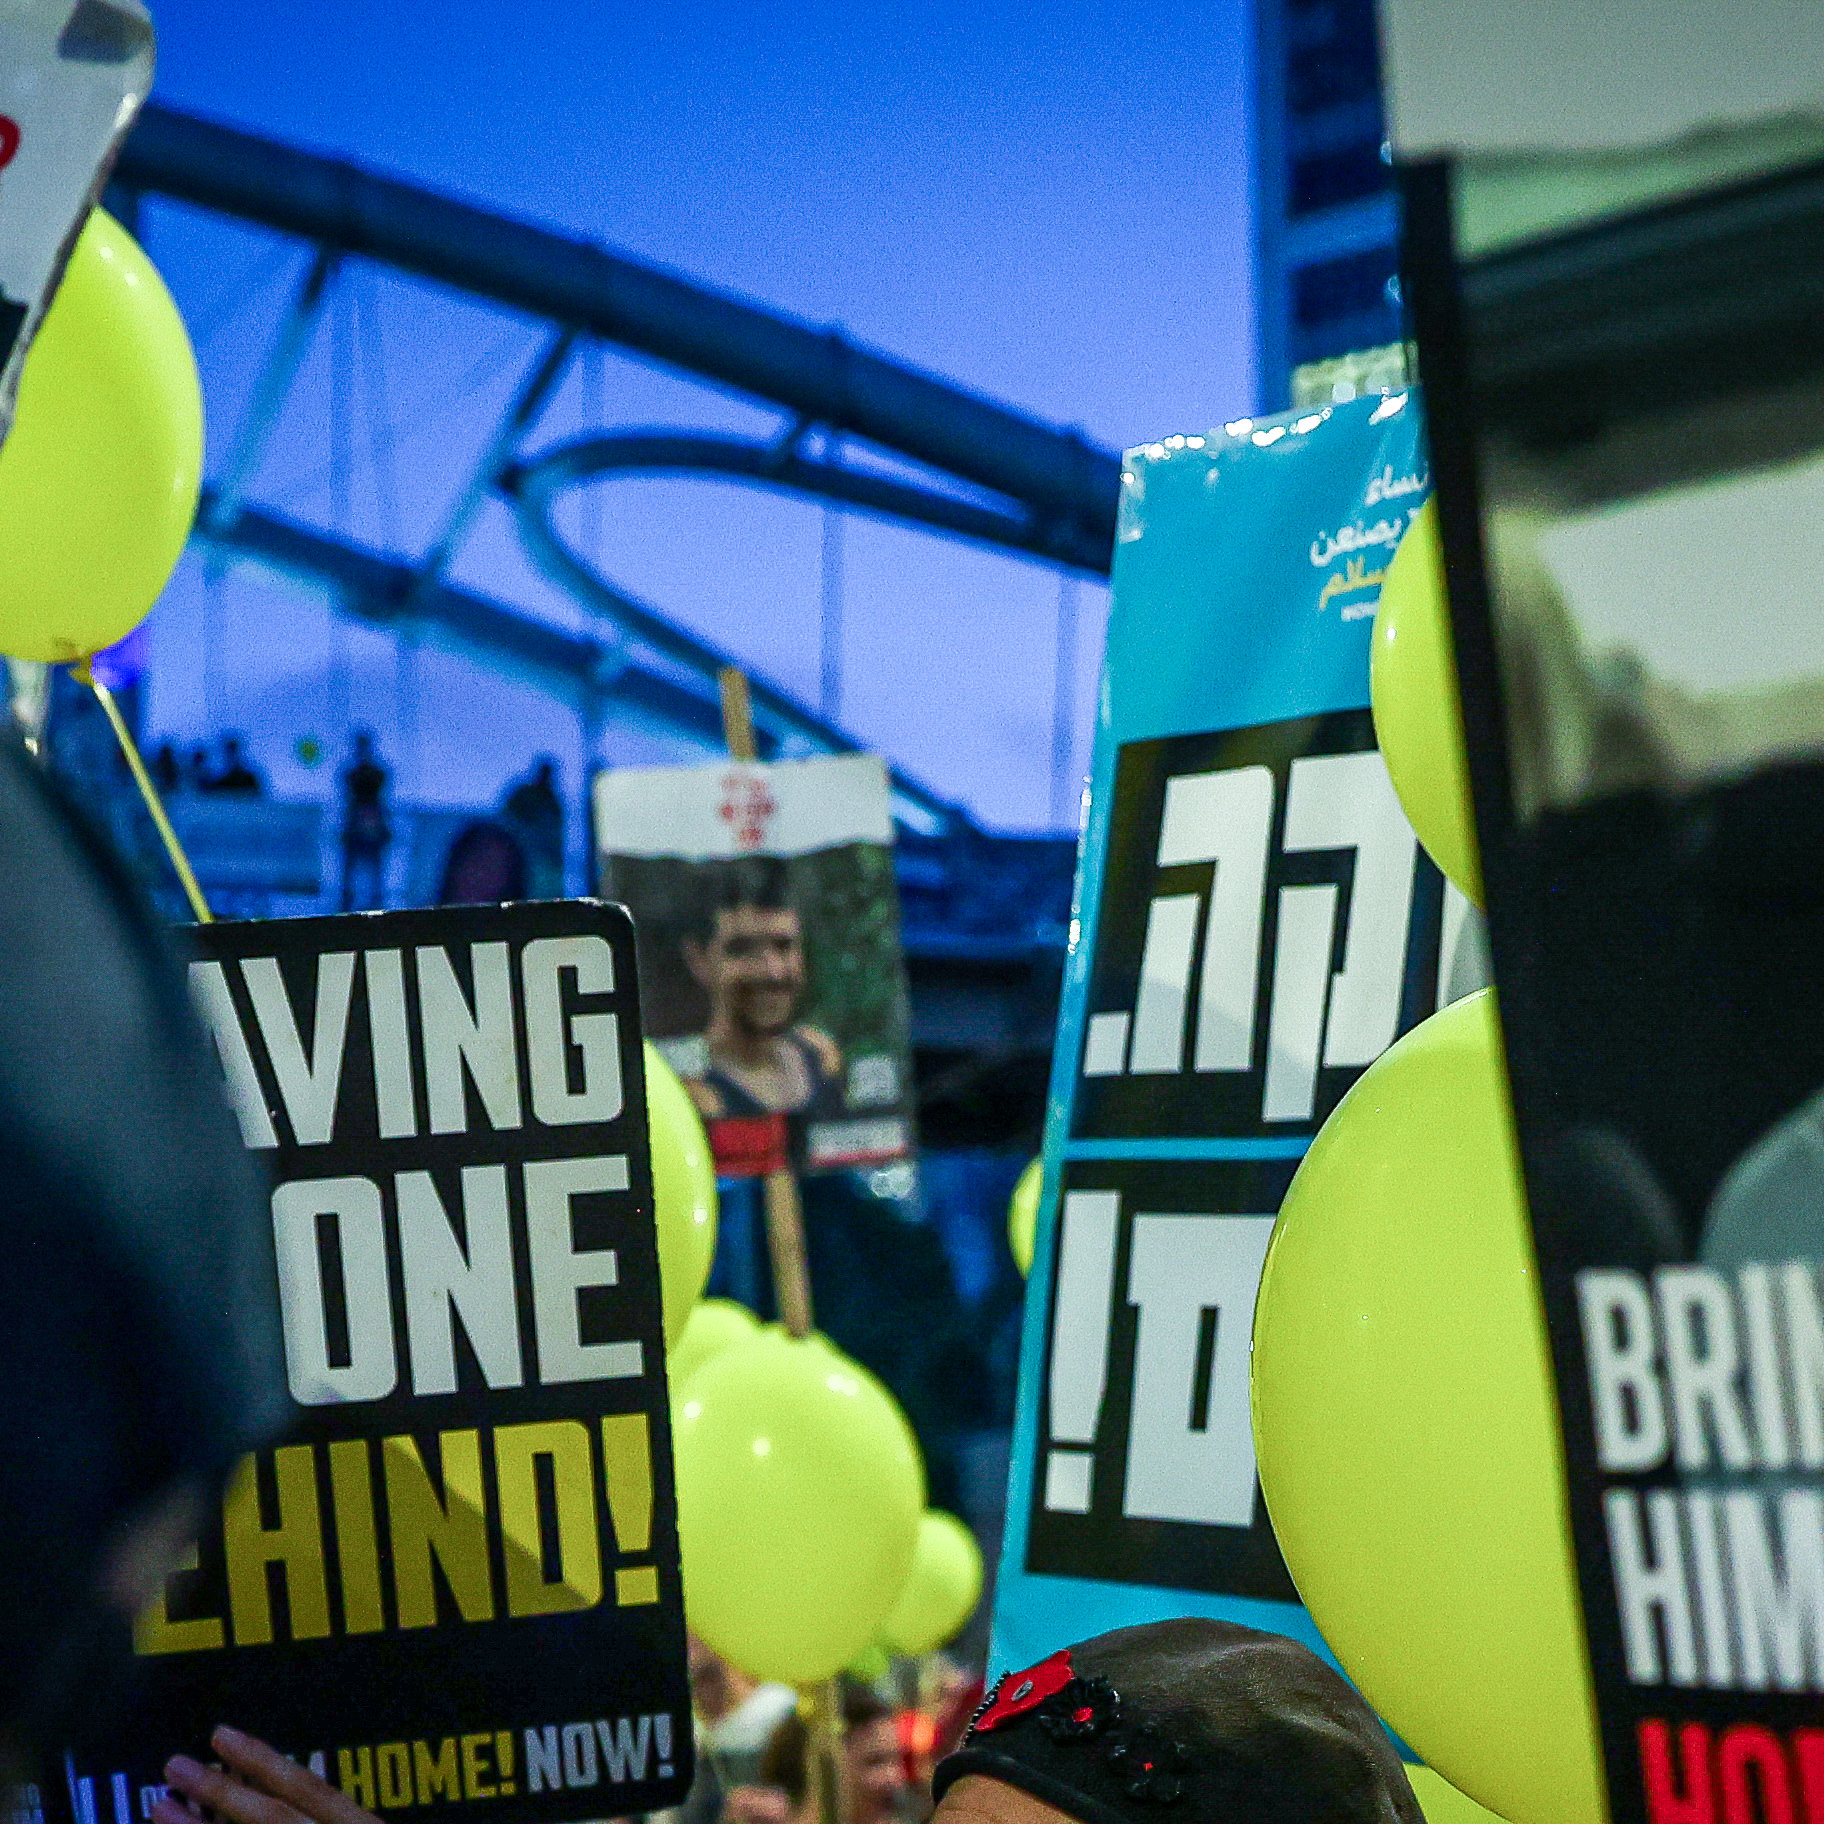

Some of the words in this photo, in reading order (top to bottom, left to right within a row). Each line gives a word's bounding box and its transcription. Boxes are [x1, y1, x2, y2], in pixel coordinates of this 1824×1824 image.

[270, 1155, 647, 1408] ONE
[337, 1729, 517, 1808] HOME!
[524, 1712, 675, 1794] NOW!
